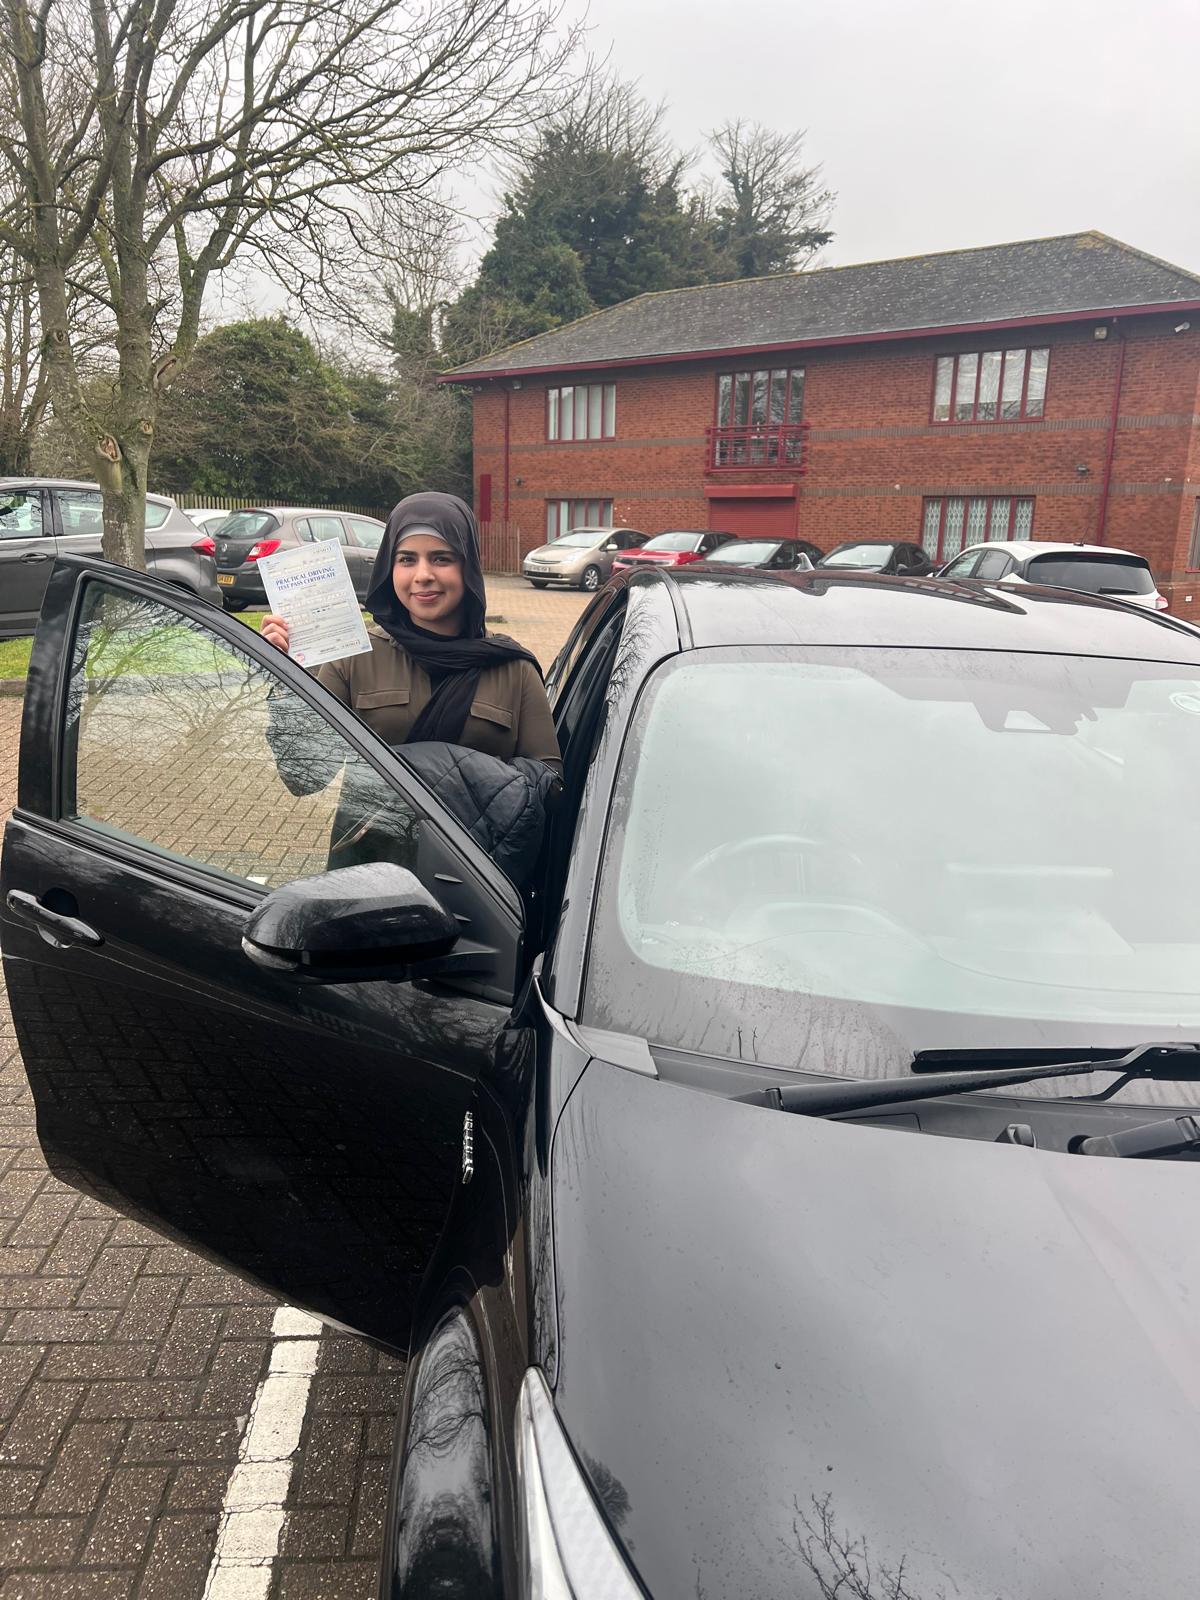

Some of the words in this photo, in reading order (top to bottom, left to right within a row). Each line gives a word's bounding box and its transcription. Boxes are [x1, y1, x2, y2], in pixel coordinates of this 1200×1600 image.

[276, 573, 306, 586] PRACTICAL
[308, 566, 335, 577] DRIVING
[291, 580, 304, 588] PASS
[304, 571, 336, 584] CERTIFICATE
